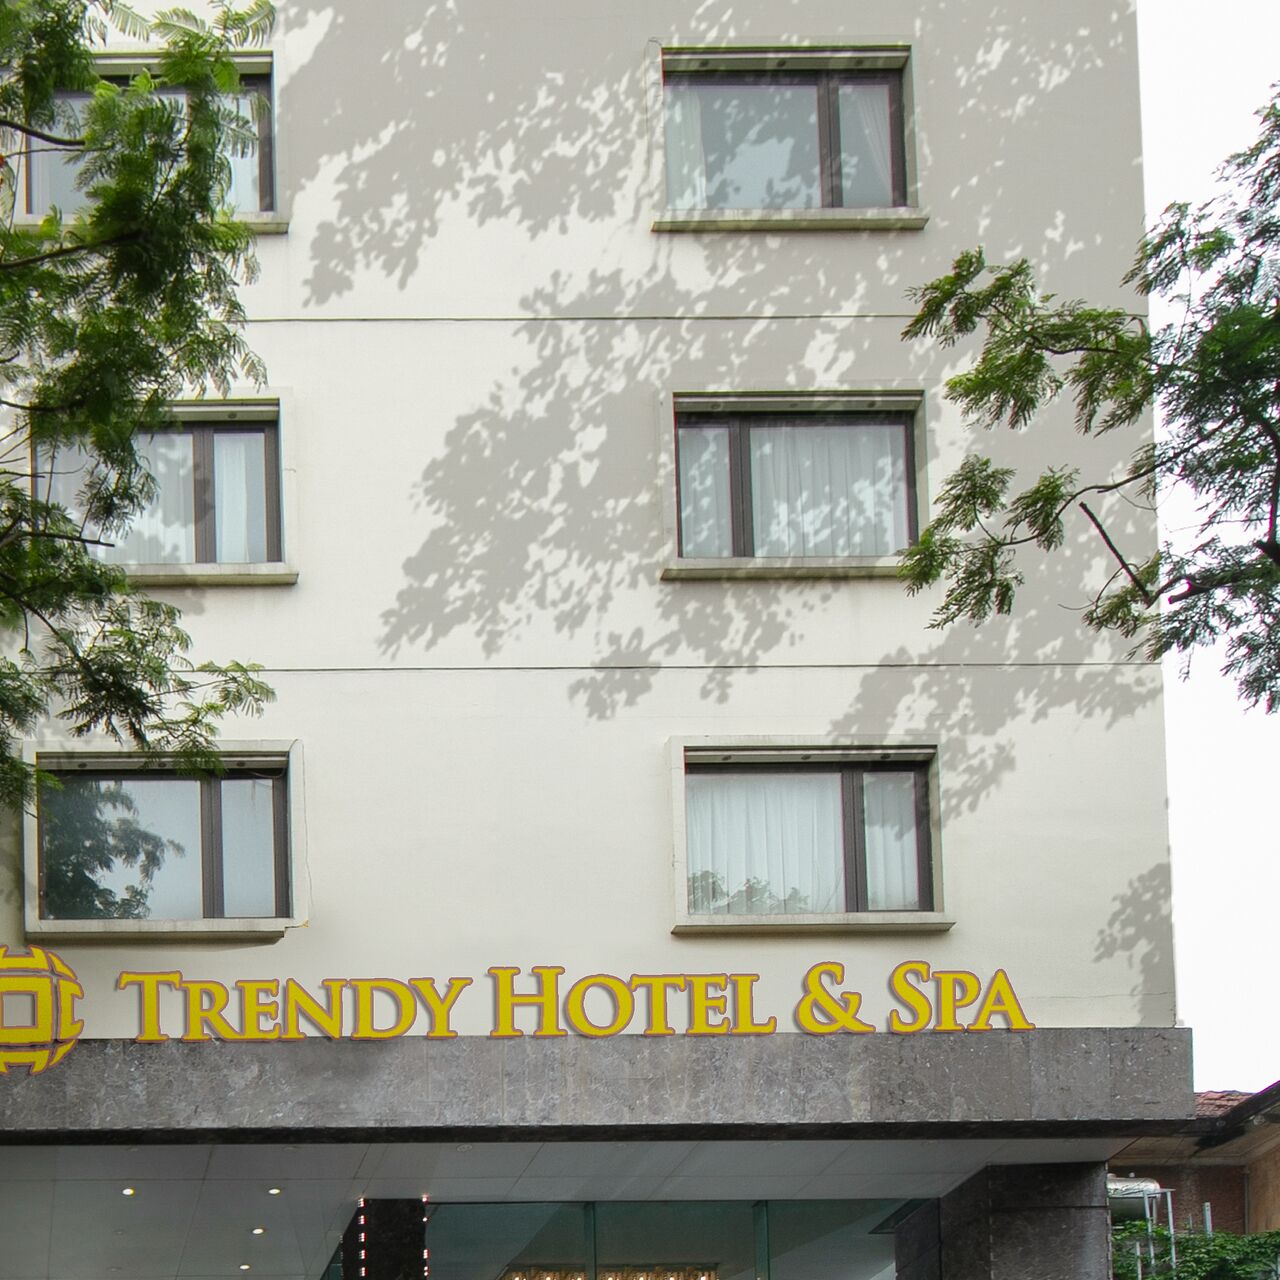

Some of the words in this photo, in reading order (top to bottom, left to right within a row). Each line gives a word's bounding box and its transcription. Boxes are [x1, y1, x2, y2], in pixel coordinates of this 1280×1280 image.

[118, 971, 472, 1042] TRENDY
[489, 966, 776, 1038] HOTEL
[795, 961, 875, 1034] &
[889, 960, 1032, 1033] SPA
